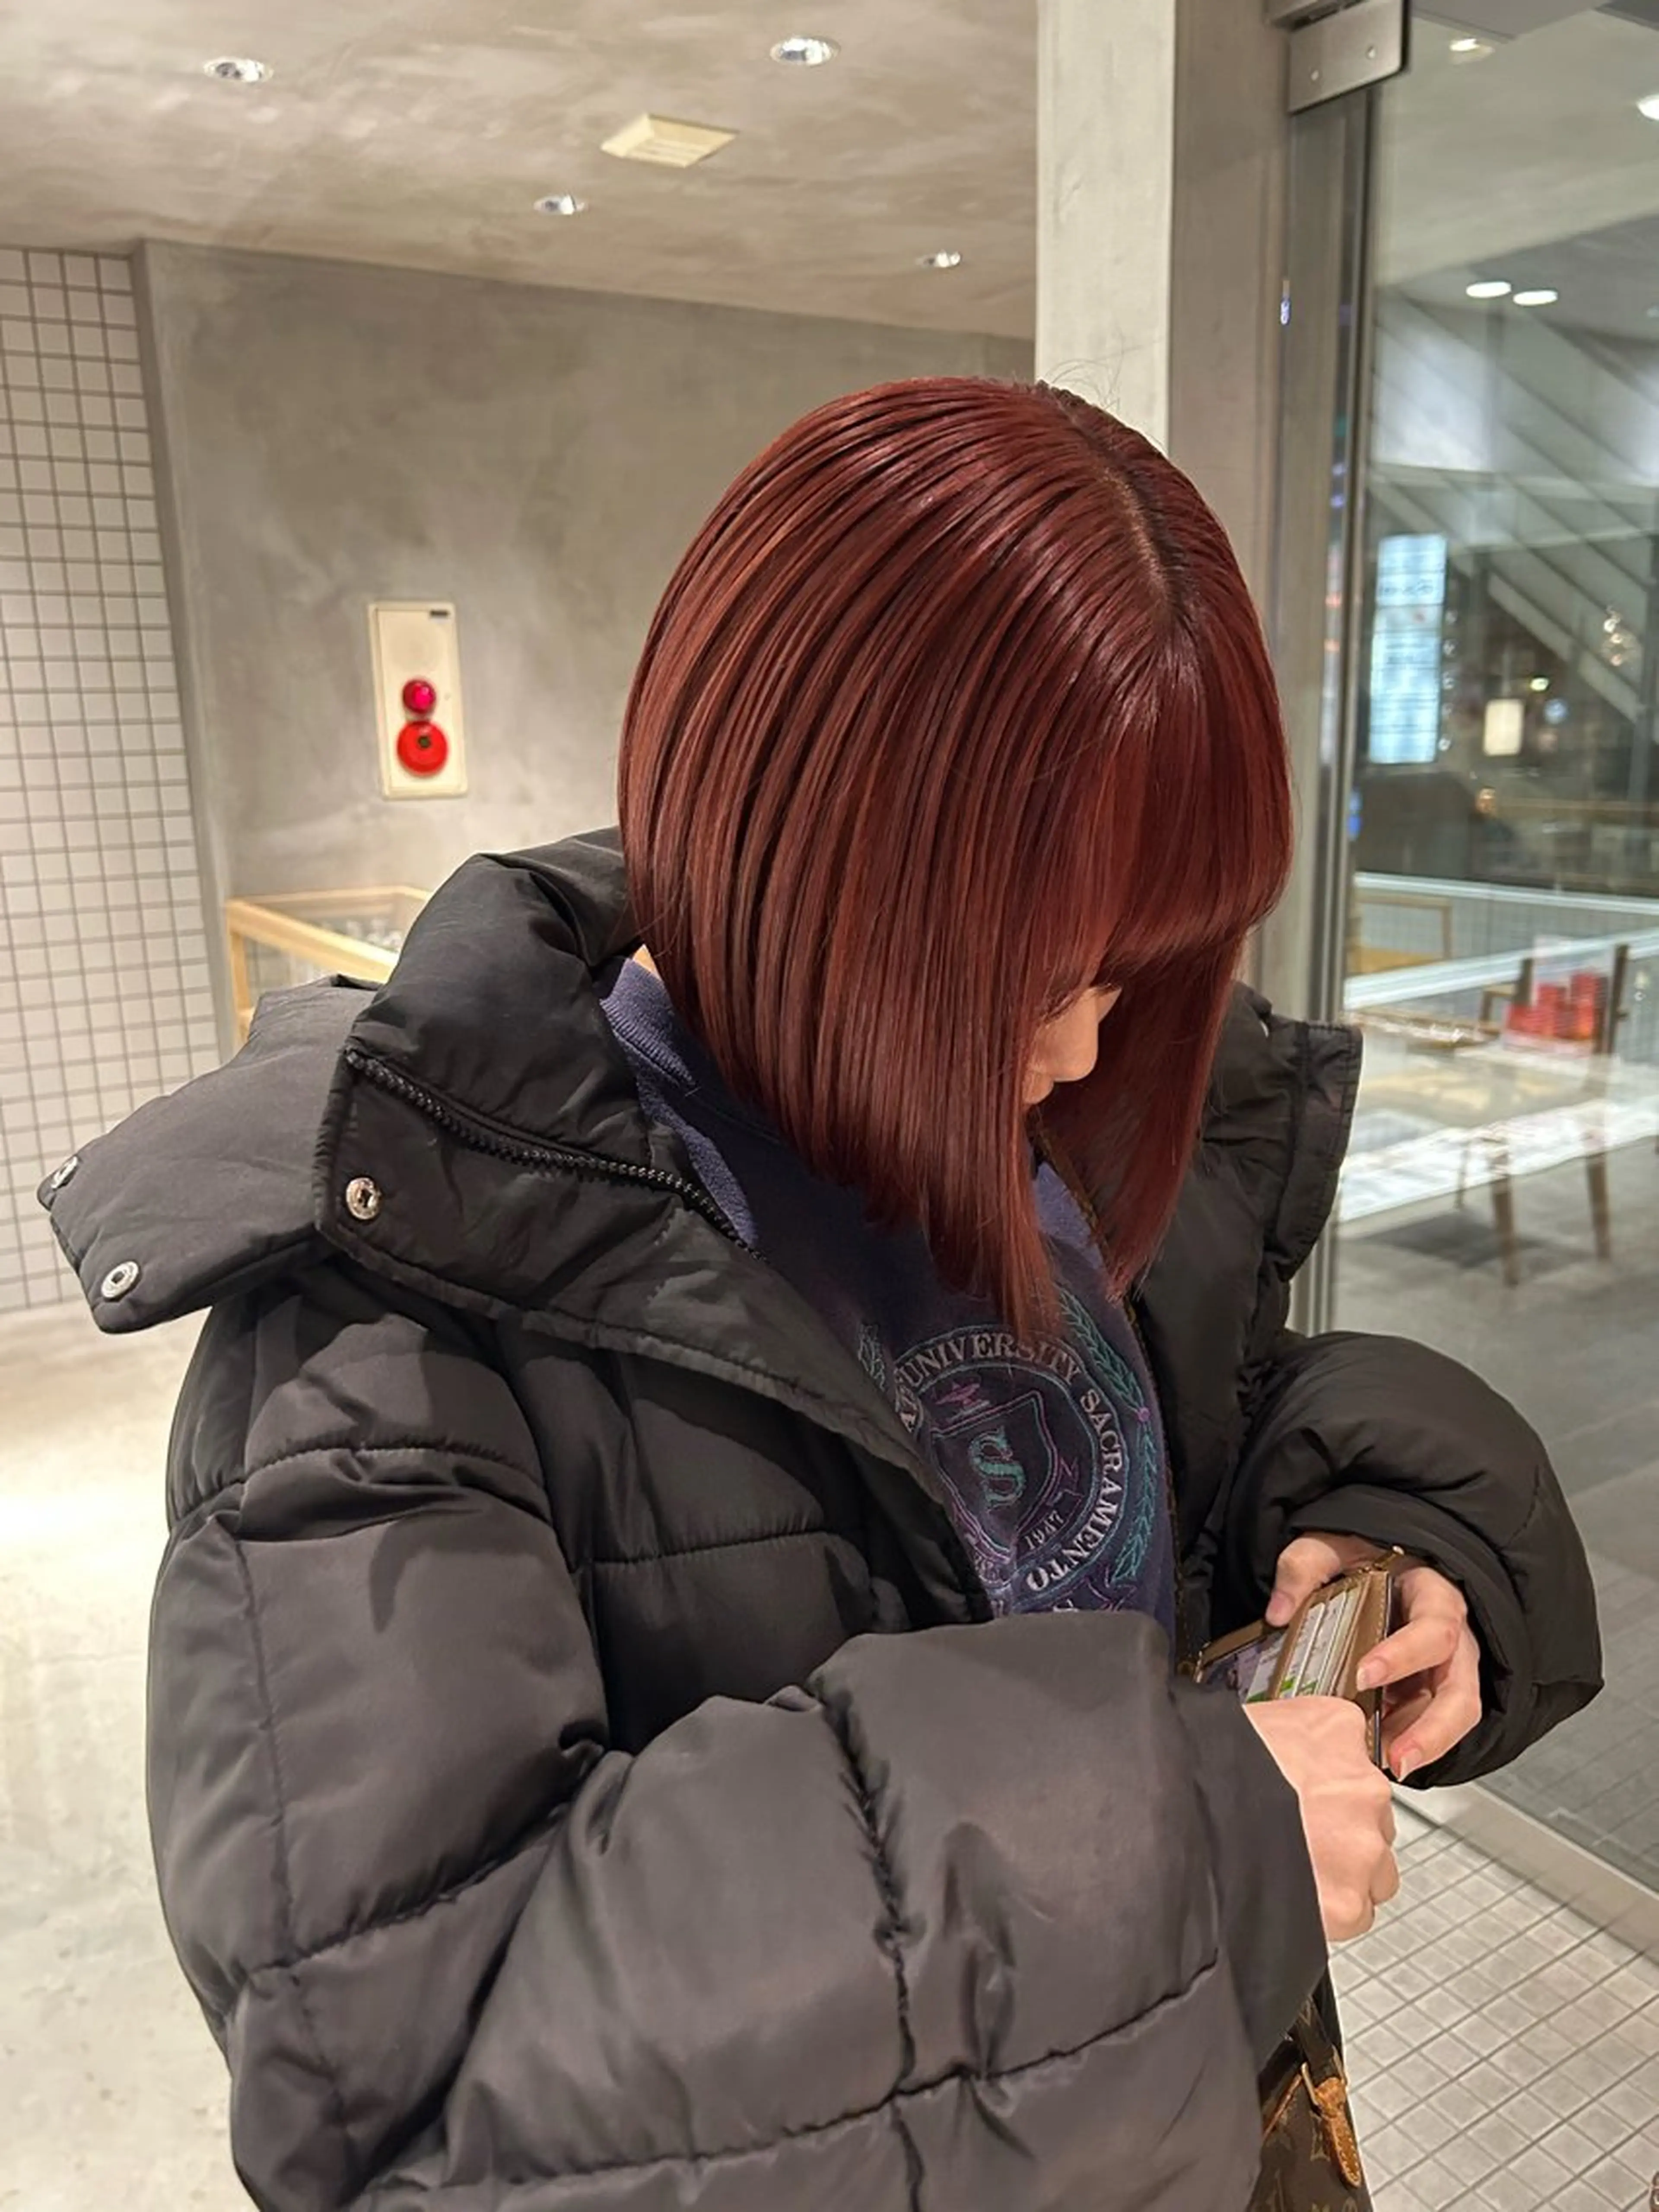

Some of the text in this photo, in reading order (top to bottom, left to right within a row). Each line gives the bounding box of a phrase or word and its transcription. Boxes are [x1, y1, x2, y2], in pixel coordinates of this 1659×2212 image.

[899, 1332, 1081, 1386] UNIVERSITY
[1023, 1389, 1123, 1591] SACRAMENTO
[1024, 1511, 1064, 1550] 1947
